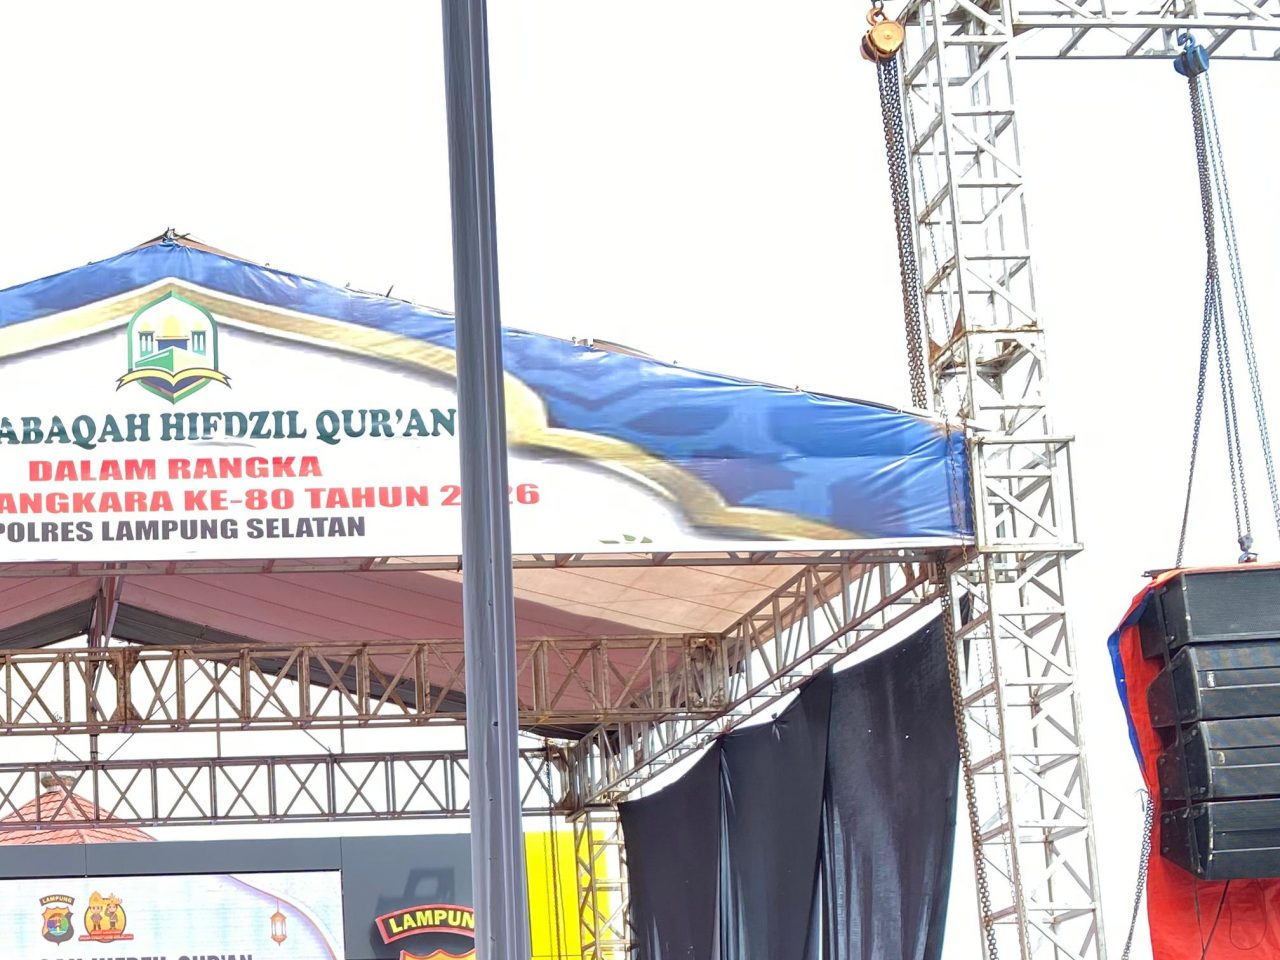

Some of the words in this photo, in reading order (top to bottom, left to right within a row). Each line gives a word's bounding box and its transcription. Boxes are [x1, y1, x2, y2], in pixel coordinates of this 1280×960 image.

[160, 410, 308, 441] HIFDZIL
[315, 408, 457, 445] QUR'AN
[28, 459, 156, 481] DALAM
[167, 456, 323, 480] RANGKA
[184, 488, 295, 511] KE-80
[304, 486, 429, 509] TAHUN
[440, 483, 540, 507] 26
[102, 518, 239, 541] LAMPUNG
[246, 516, 366, 539] SELATAN
[389, 909, 475, 934] LAMPUN
